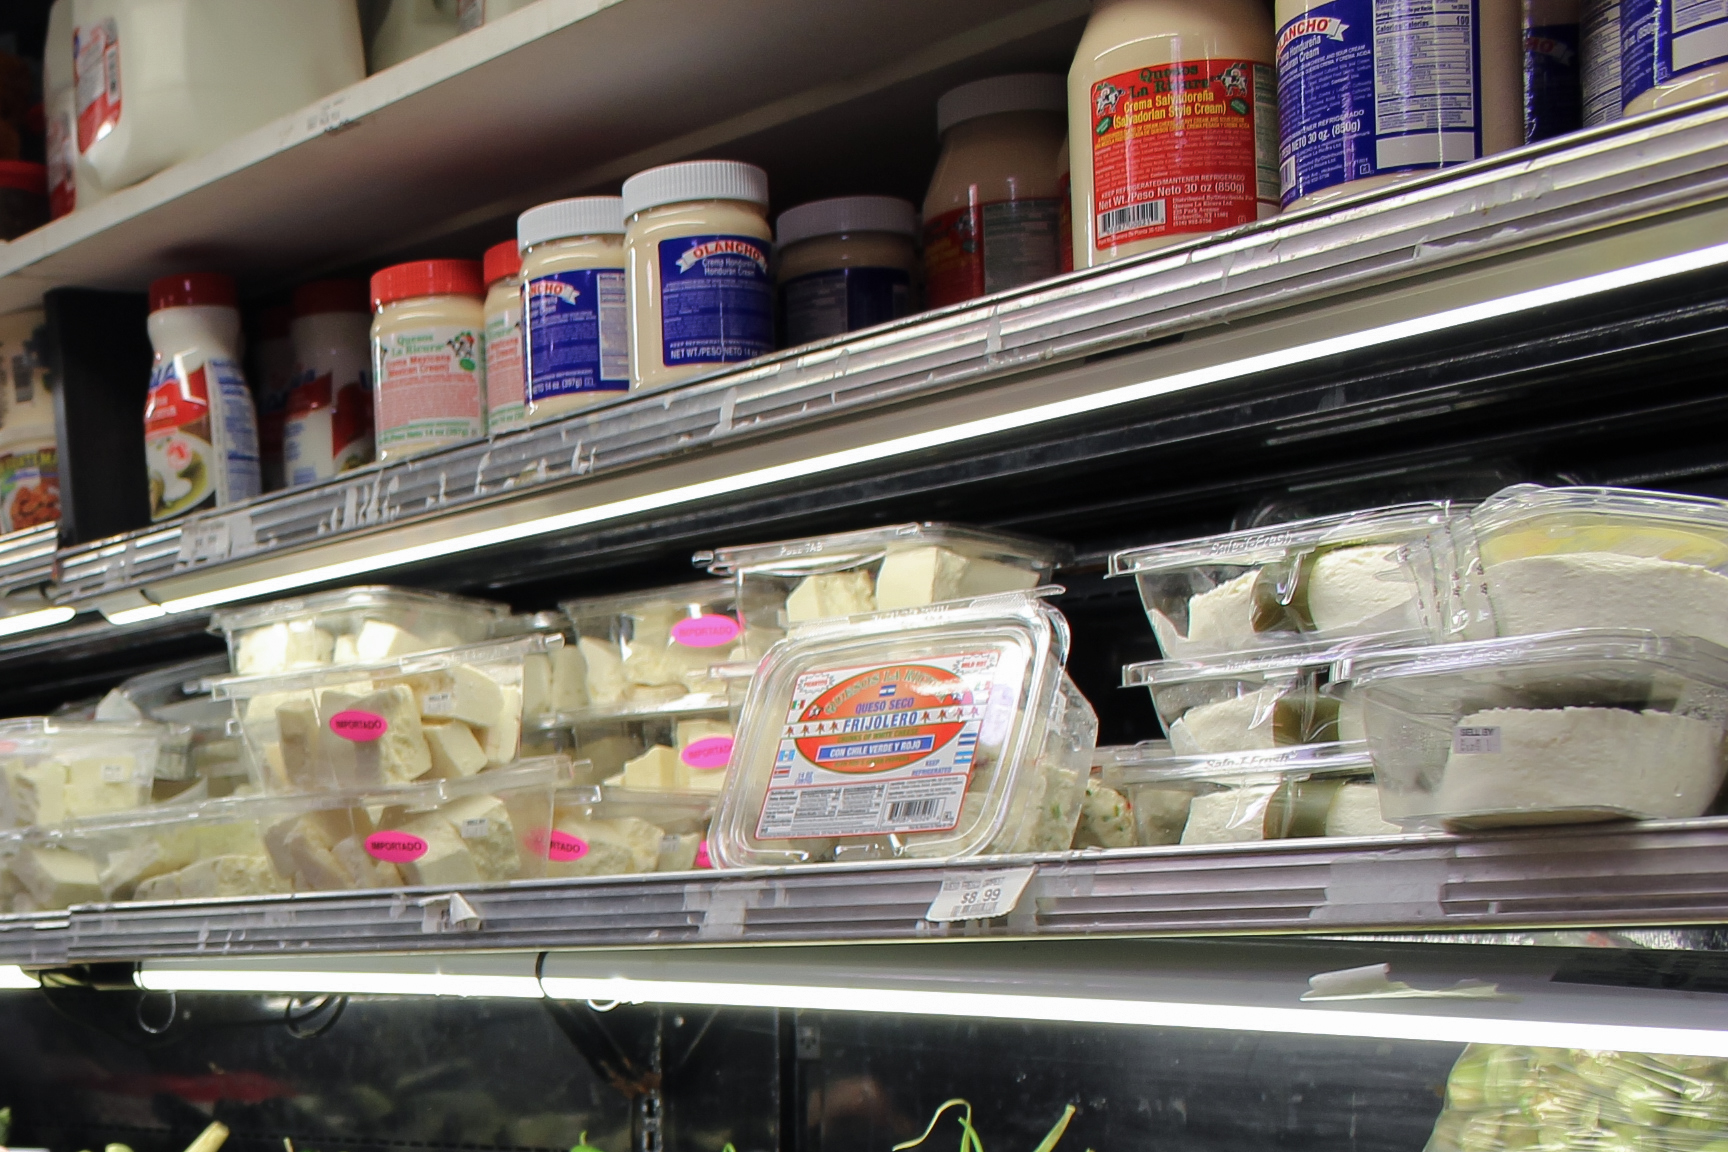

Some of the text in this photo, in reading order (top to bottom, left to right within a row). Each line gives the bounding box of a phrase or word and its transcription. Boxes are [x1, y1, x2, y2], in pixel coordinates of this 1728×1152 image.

[1124, 90, 1214, 113] Crema Salvadoreña
[1194, 101, 1227, 115] Cream)
[1308, 131, 1317, 145] 30
[1331, 119, 1361, 138] (850g)
[1157, 184, 1182, 198] Neto
[1184, 183, 1199, 195] 30
[1200, 183, 1213, 193] oz
[1215, 182, 1246, 194] (850g)
[693, 241, 761, 260] OLANCHO
[702, 259, 724, 269] Crema
[670, 349, 685, 360] NET
[723, 347, 743, 357] NETO
[855, 697, 915, 715] QUESO SECO
[335, 719, 382, 730] IMPORTADO
[843, 711, 919, 733] FRIJOLERO
[1460, 728, 1494, 737] SELL BY
[829, 748, 845, 758] CON
[847, 745, 868, 757] CHILE
[869, 743, 893, 754] VERDE
[900, 740, 922, 751] ROJO
[371, 841, 422, 852] IMPORTADO
[550, 840, 581, 853] RTADO
